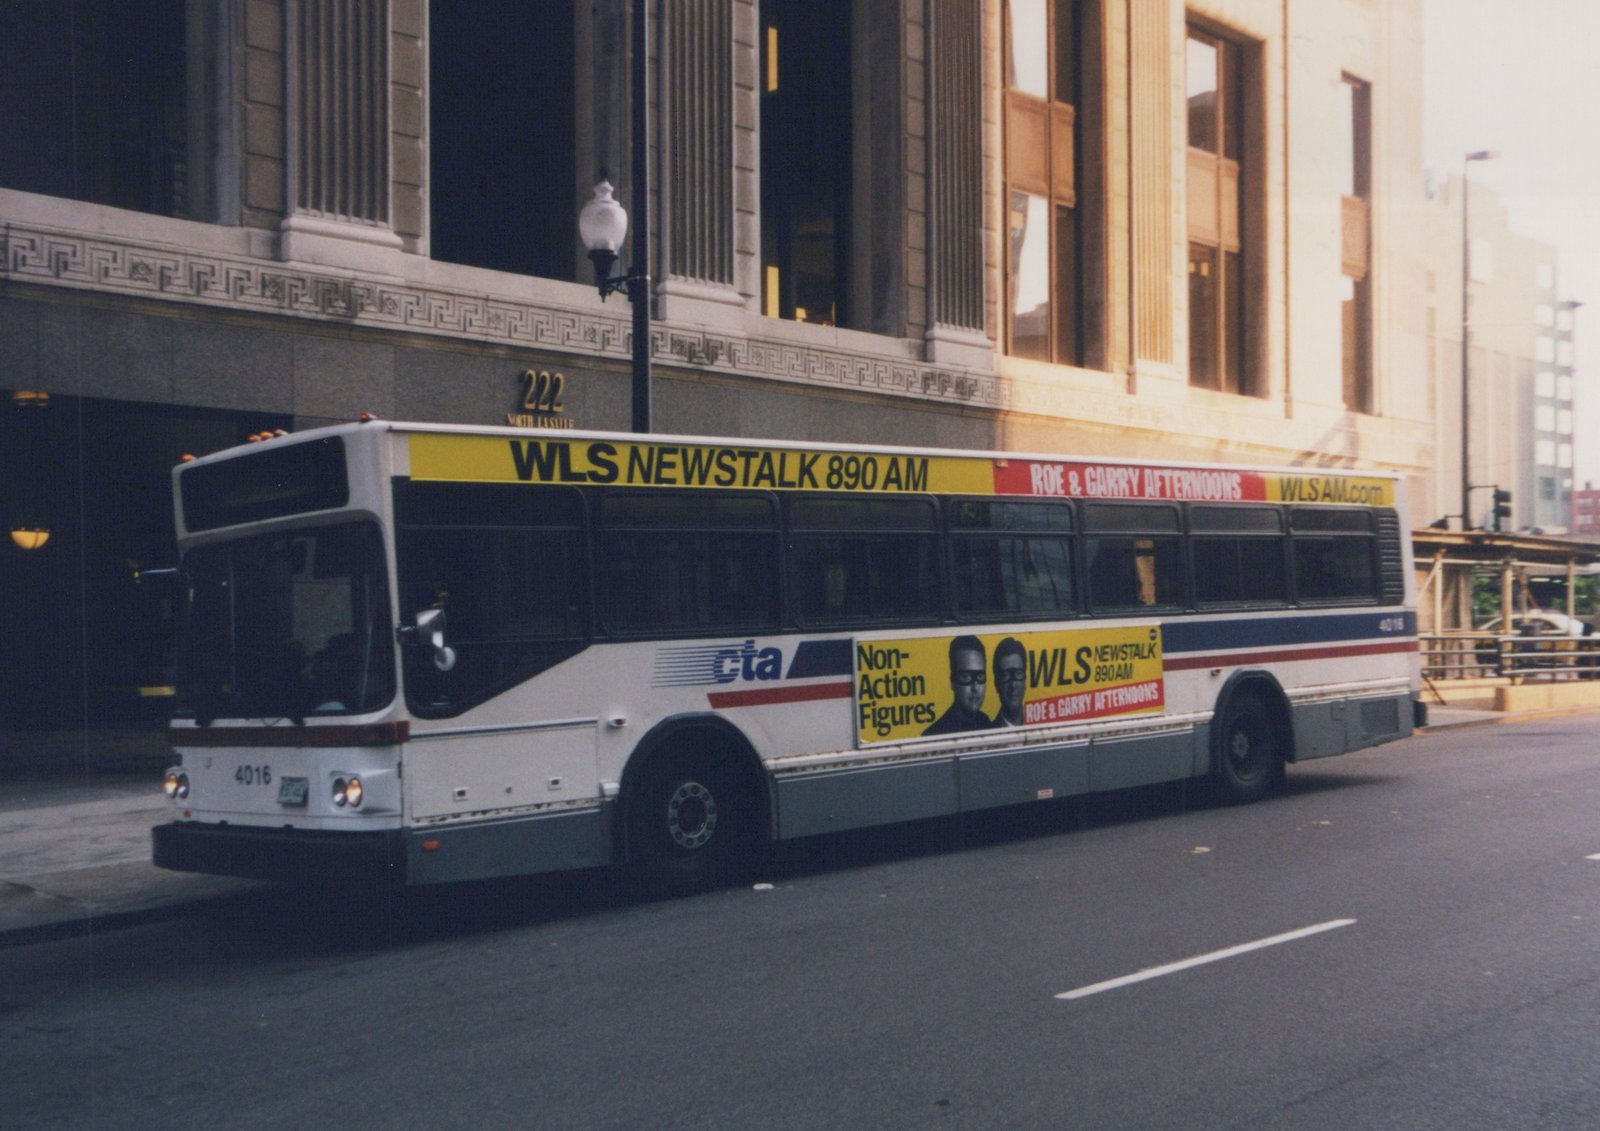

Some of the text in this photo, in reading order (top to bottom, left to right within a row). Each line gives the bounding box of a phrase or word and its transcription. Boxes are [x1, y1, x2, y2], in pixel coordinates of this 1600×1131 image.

[523, 368, 565, 413] 222
[509, 440, 929, 491] WLS NEWSTALK 890 AM
[1030, 463, 1242, 500] ROE & GARRY AFTERNOONS
[713, 640, 782, 684] cta
[857, 644, 909, 671] Non-
[1028, 646, 1092, 688] WLS
[1094, 642, 1156, 663] NEWSTALK
[859, 671, 925, 700] Action
[1026, 683, 1158, 723] ROE & GARRY AFTERNOONS
[860, 702, 936, 737] Figures
[235, 765, 271, 785] 4016
